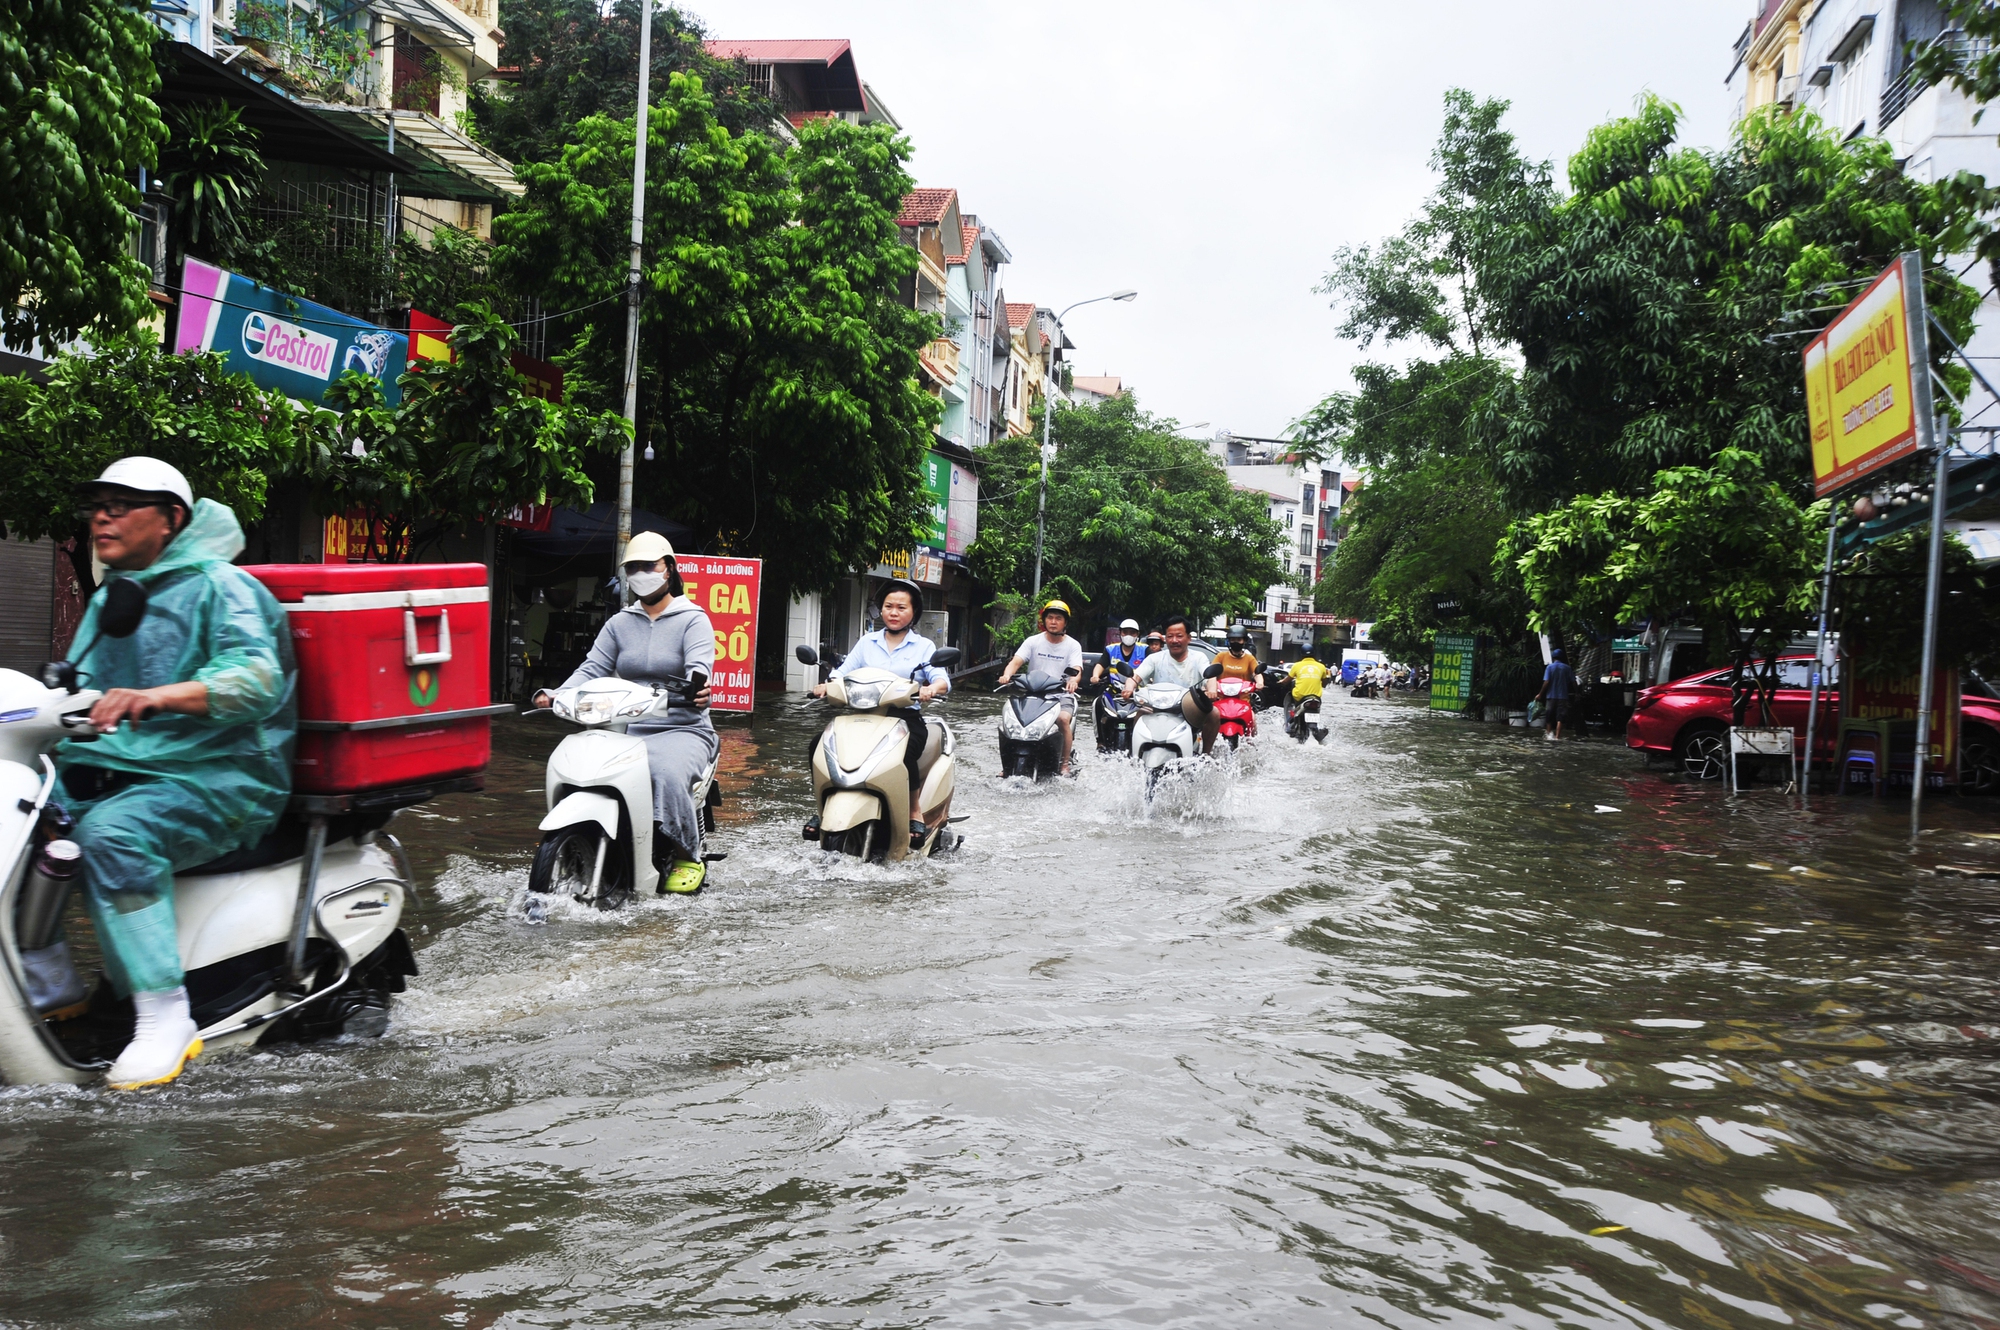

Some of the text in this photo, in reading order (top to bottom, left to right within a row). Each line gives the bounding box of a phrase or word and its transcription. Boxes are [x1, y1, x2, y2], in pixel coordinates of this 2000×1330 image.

[265, 323, 331, 374] Castrol
[525, 374, 552, 400] ET
[676, 562, 699, 574] CHỮA
[706, 562, 723, 575] BẢO
[725, 564, 754, 576] DƯỠNG
[709, 583, 752, 615] GA
[714, 621, 751, 662] SỐ
[1433, 650, 1462, 666] PHỞ
[711, 671, 726, 687] AY
[1432, 666, 1460, 681] BÚN
[1431, 681, 1459, 697] MIẾN
[1889, 674, 1934, 700] CHỌ
[727, 694, 737, 704] XE
[738, 693, 750, 705] CŨ
